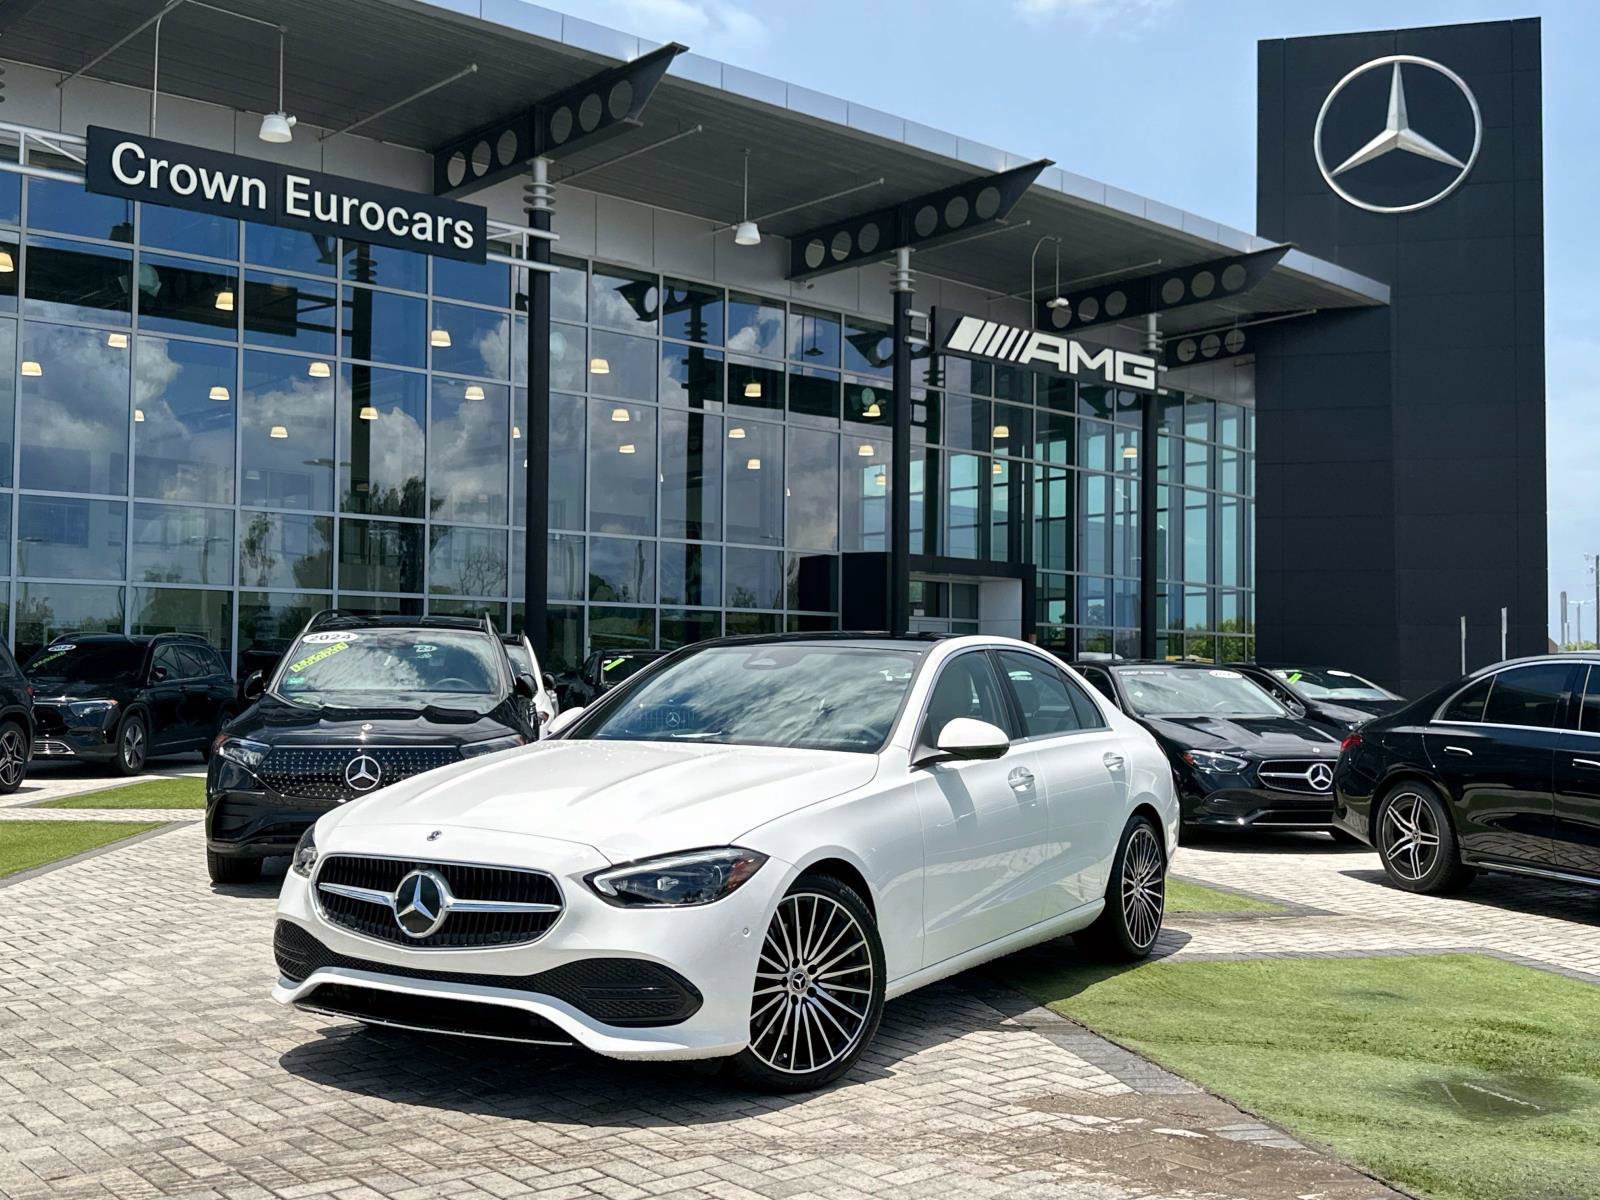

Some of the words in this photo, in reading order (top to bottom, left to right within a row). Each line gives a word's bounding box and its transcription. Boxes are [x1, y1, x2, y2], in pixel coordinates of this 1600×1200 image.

[111, 141, 267, 210] Crown
[286, 174, 474, 250] Eurocars
[1018, 331, 1155, 390] AMG
[309, 633, 351, 642] 2024
